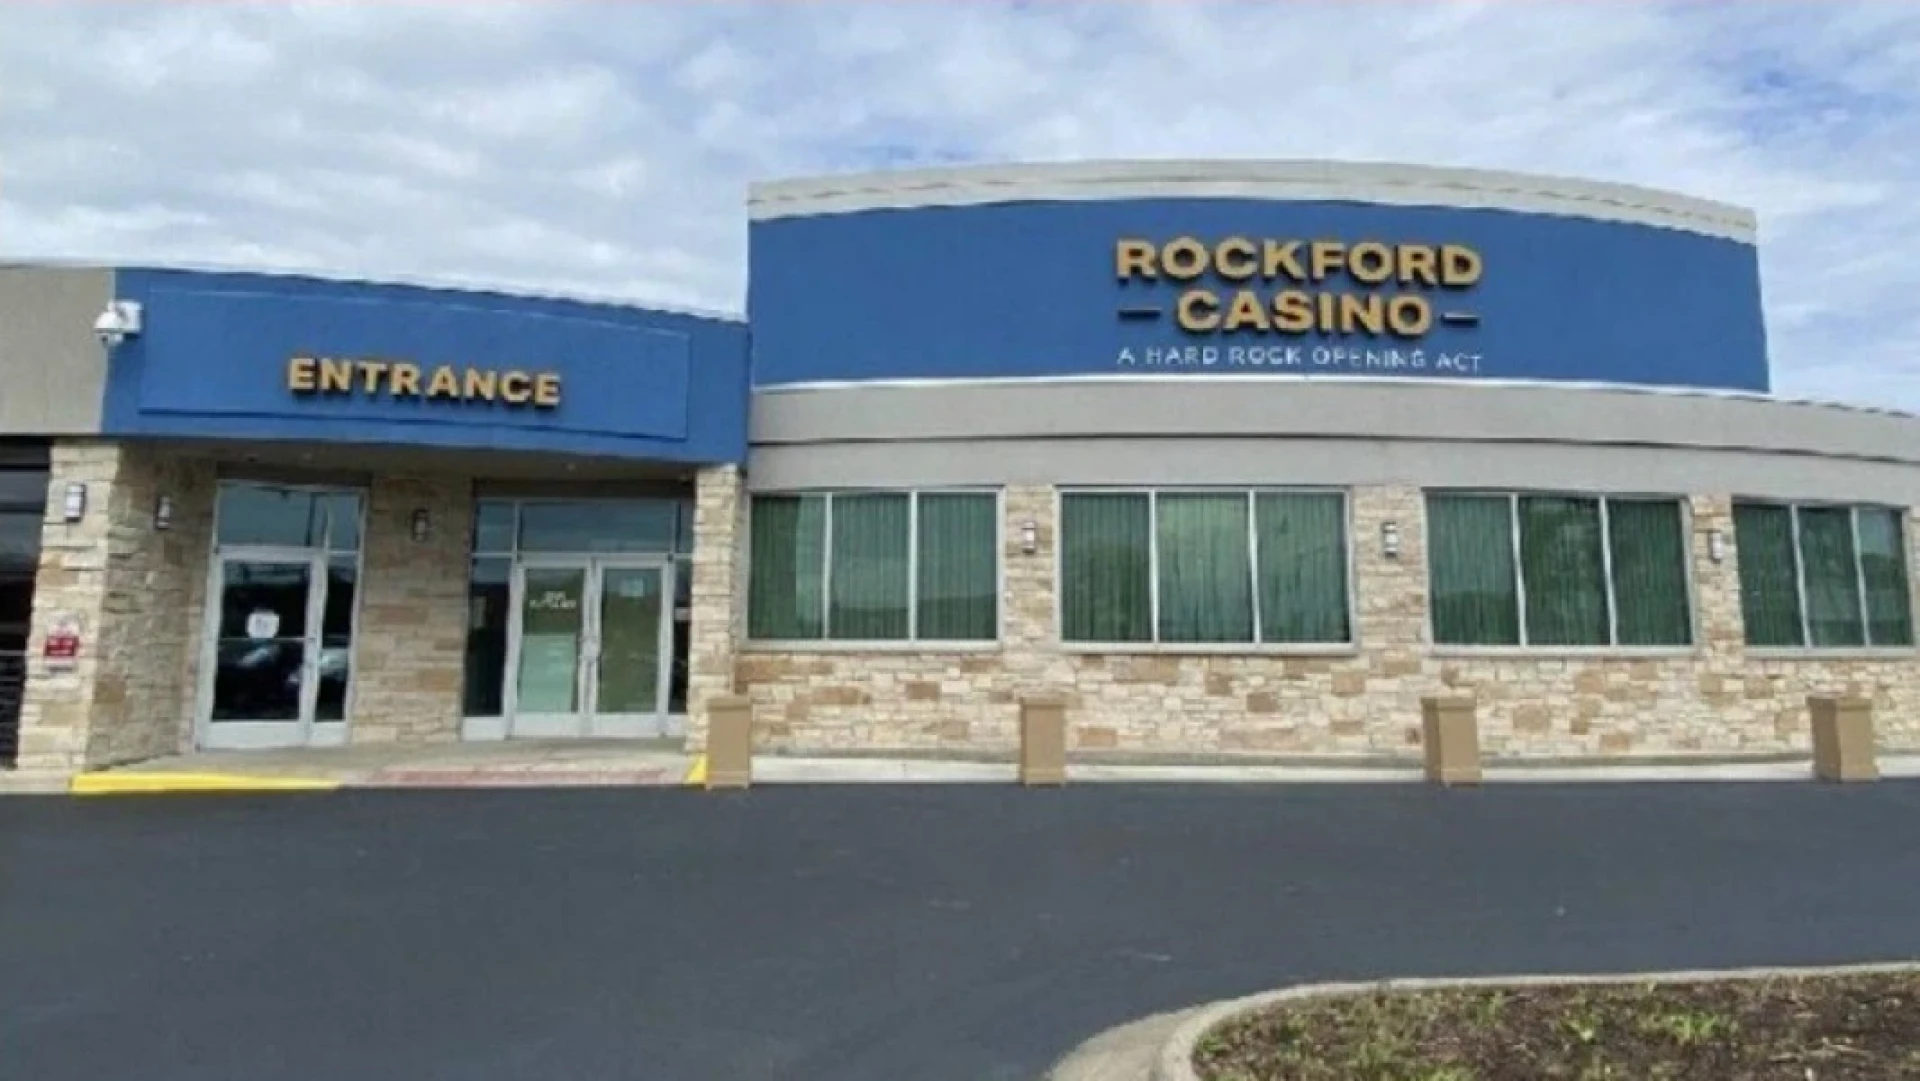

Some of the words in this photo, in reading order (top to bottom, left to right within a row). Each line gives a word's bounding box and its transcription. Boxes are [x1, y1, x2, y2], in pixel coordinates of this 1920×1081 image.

[1116, 236, 1483, 286] ROCKFORD
[1177, 288, 1433, 336] CASINO
[288, 357, 561, 407] ENTRANCE
[1116, 347, 1136, 365] A
[1147, 347, 1217, 366] HARD
[1229, 347, 1301, 366] ROCK
[1313, 347, 1426, 368] OPENING
[1437, 350, 1484, 371] ACT
